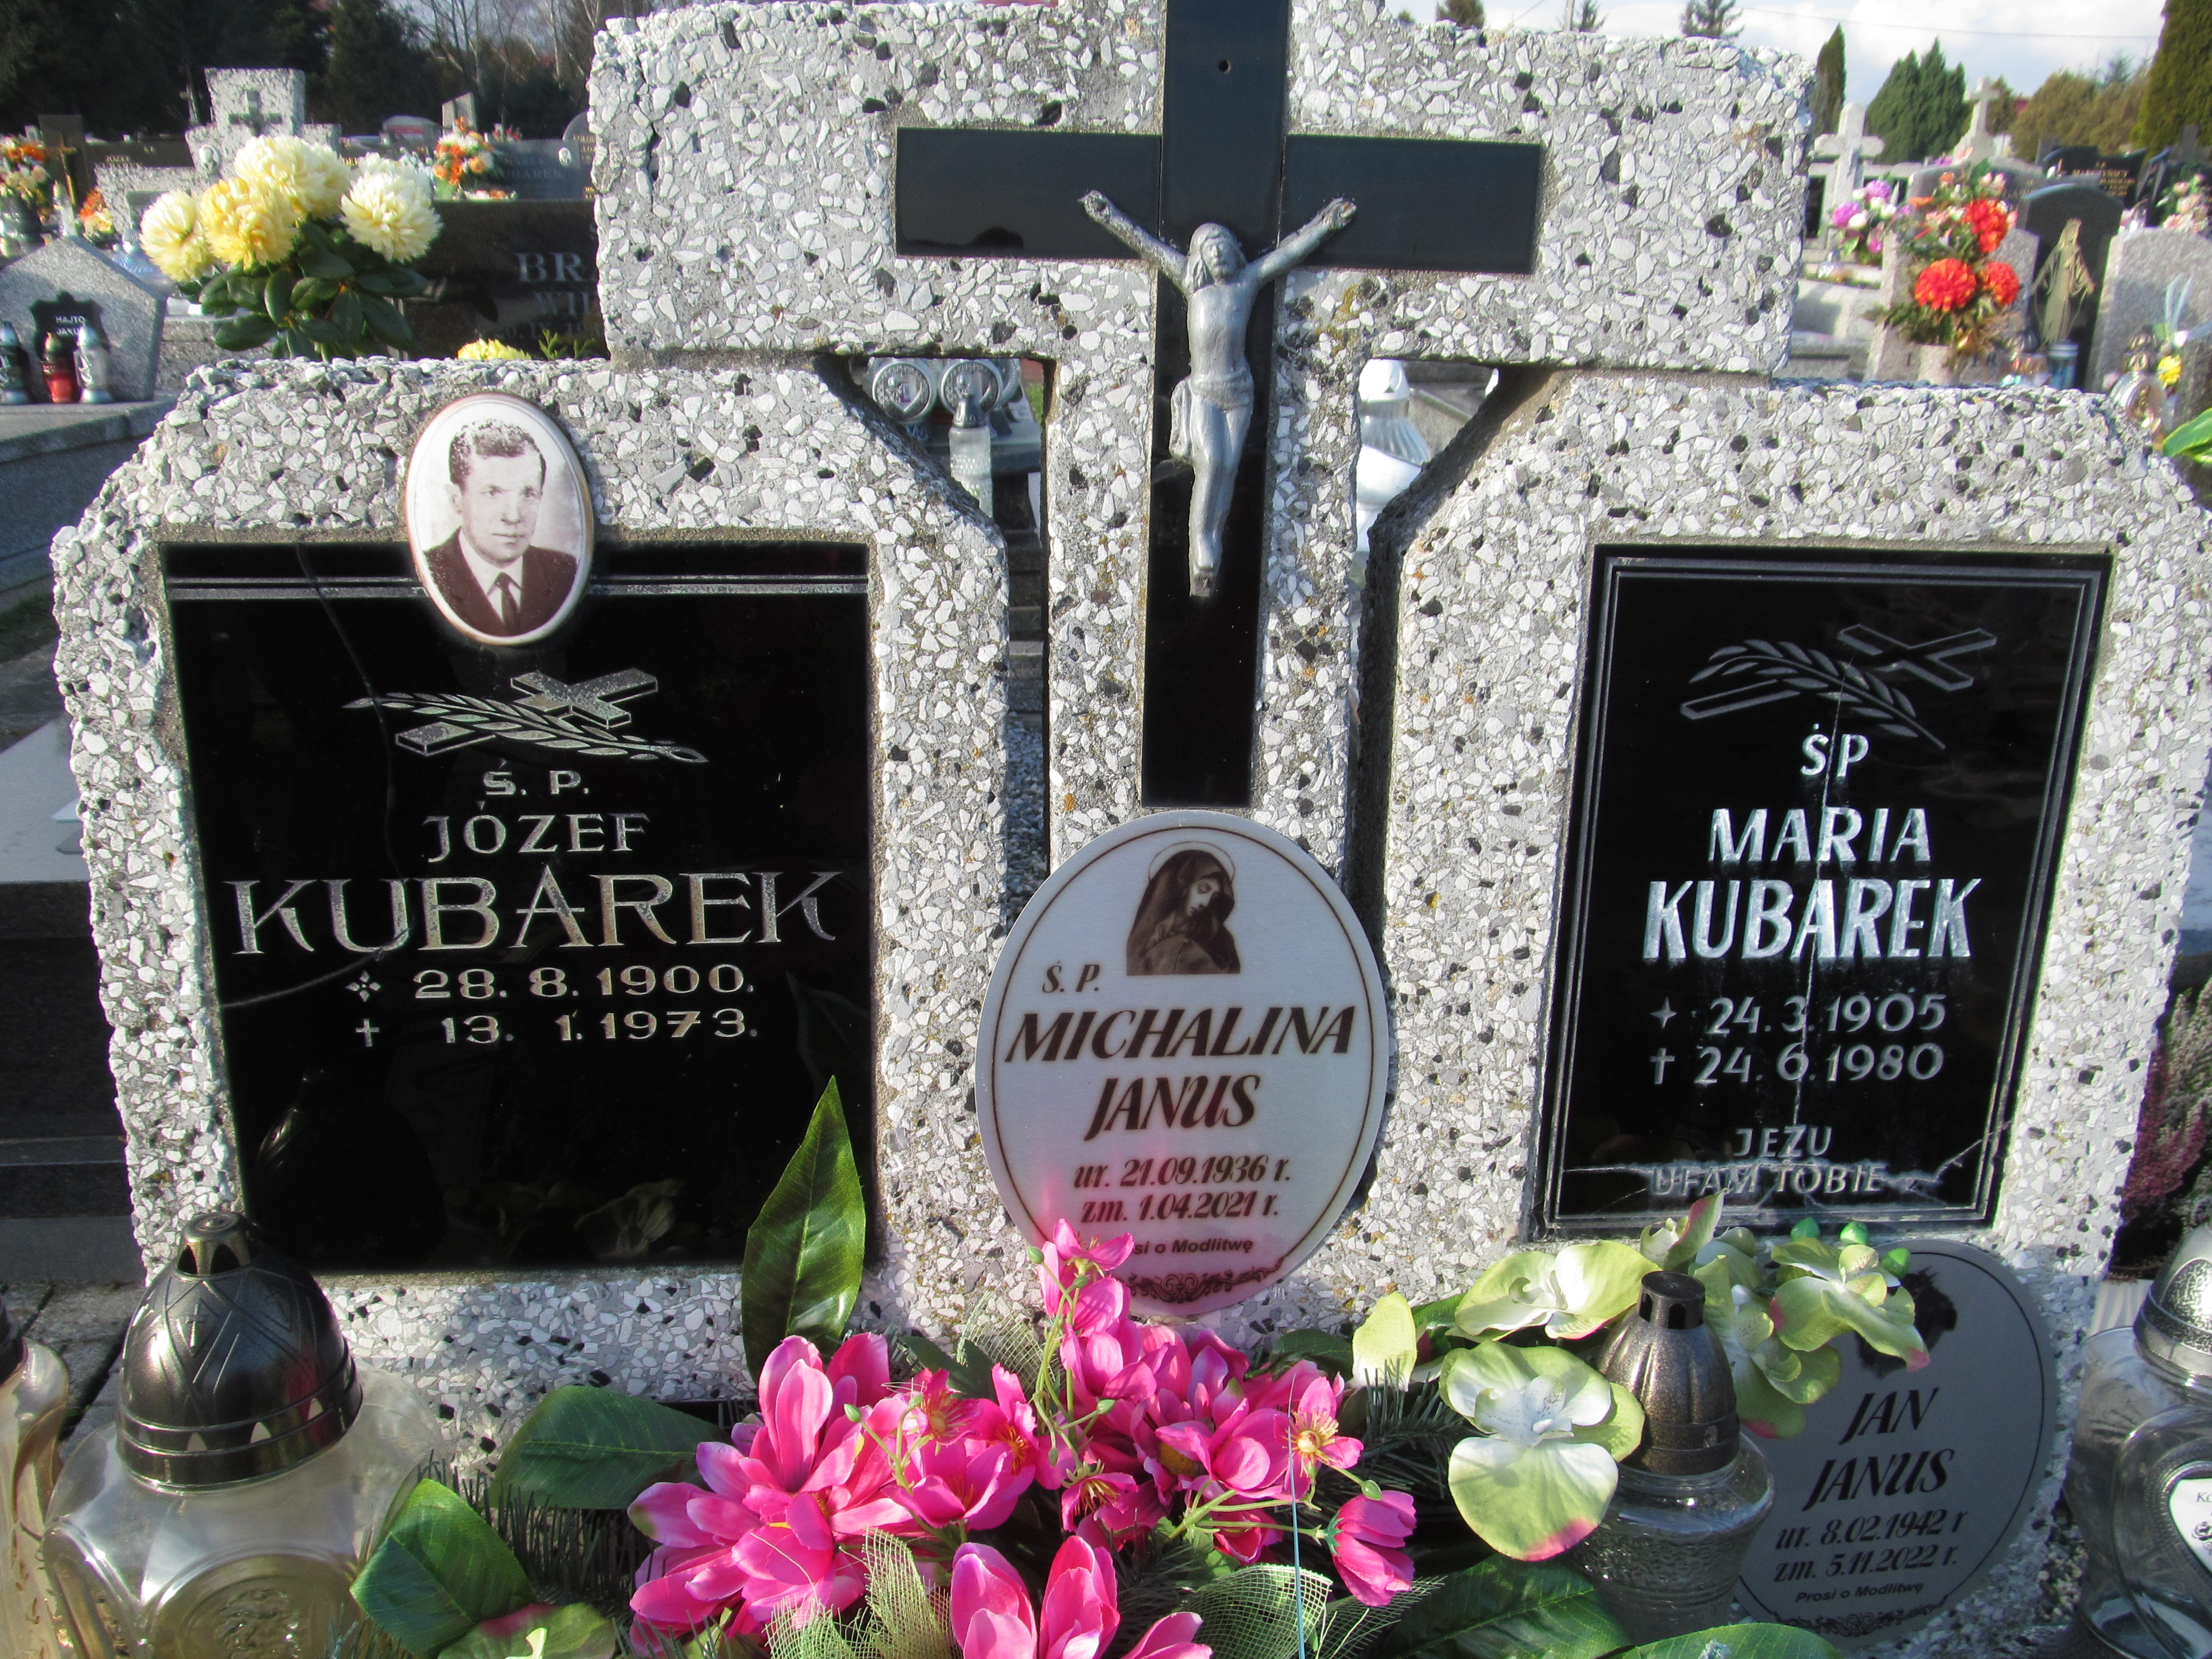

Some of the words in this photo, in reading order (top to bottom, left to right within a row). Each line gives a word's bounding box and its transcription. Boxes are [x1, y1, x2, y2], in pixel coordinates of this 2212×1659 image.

[55, 315, 86, 324] HAJTO
[422, 801, 650, 863] JÓZEF
[1708, 806, 1931, 862] MARIA
[223, 864, 843, 954] KUBAREK
[1643, 878, 1982, 960] KUBAREK
[1005, 1006, 1355, 1062] MICHALINA
[1084, 1075, 1261, 1141] JANUS
[1733, 1126, 1833, 1157] JEZU
[1074, 1162, 1110, 1188] ur.
[1120, 1155, 1268, 1187] 21.09.1936
[1274, 1158, 1291, 1182] r.
[1652, 1165, 1761, 1196] UFAM
[1771, 1162, 1888, 1194] TOBIE
[1081, 1200, 1128, 1223] zm.
[1139, 1190, 1258, 1221] 1.04.2021
[1262, 1193, 1279, 1217] r.
[1155, 1243, 1166, 1254] o
[1172, 1238, 1253, 1254] Modlitwę
[1838, 1387, 1941, 1445] JAN
[1801, 1448, 1955, 1512] JANUS
[1776, 1526, 1810, 1549] ur.
[1820, 1508, 1948, 1546] 8.02.1942
[1951, 1511, 1968, 1533] r
[1773, 1560, 1817, 1583] zm.
[1826, 1544, 1940, 1577] 5.11.2022
[1942, 1545, 1958, 1566] r.
[1795, 1588, 1837, 1603] Prosi
[1855, 1582, 1924, 1598] Modlitwę
